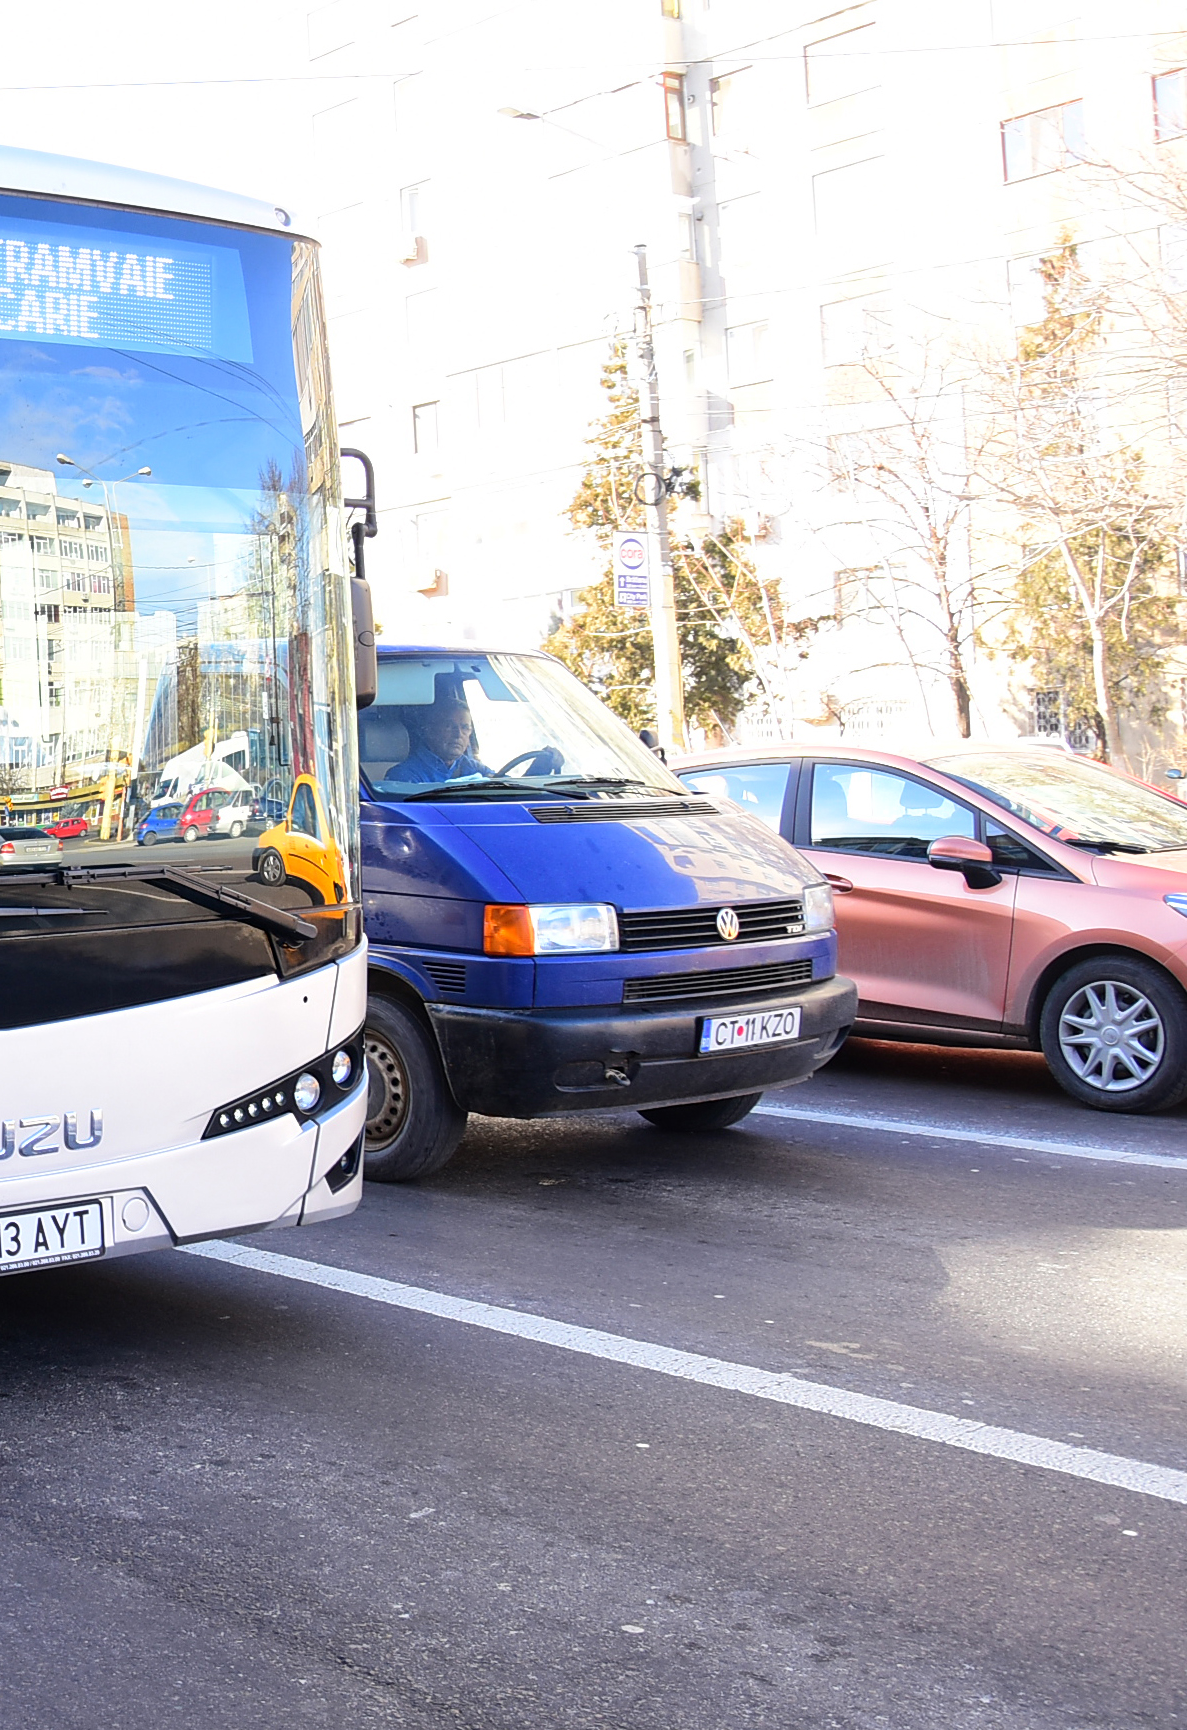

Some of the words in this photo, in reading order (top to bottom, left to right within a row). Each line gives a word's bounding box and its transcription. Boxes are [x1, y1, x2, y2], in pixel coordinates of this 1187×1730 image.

[620, 548, 644, 559] cora
[716, 1020, 739, 1046] CT
[760, 1011, 795, 1039] KZO
[33, 1209, 90, 1253] AYT
